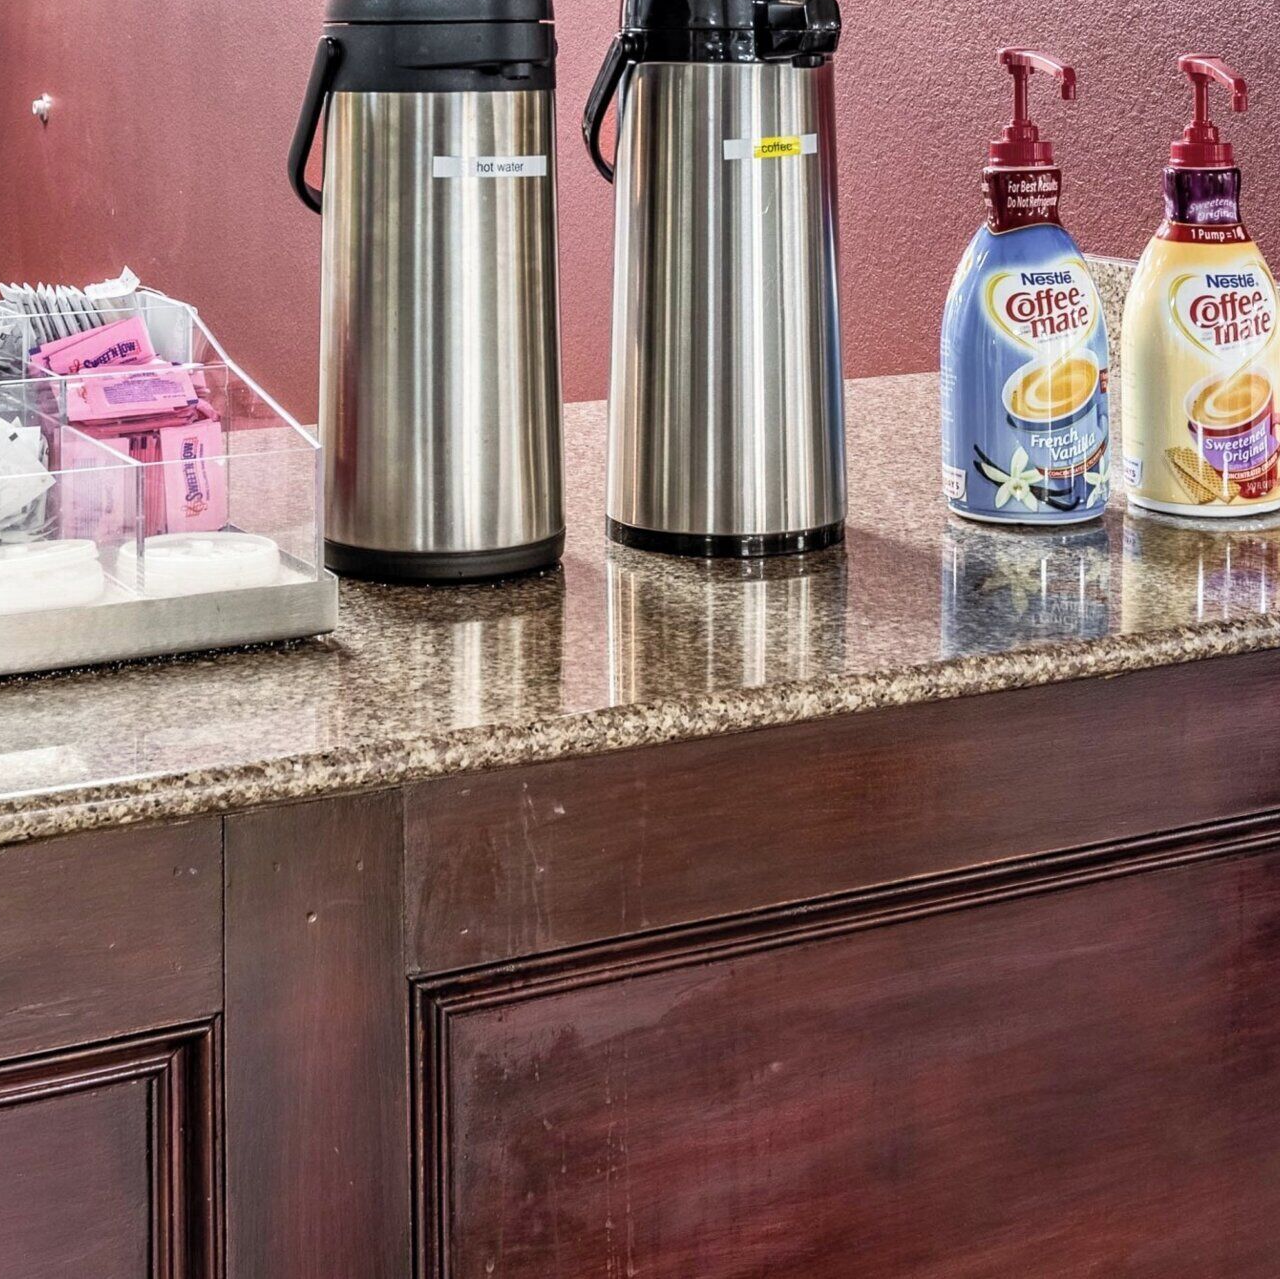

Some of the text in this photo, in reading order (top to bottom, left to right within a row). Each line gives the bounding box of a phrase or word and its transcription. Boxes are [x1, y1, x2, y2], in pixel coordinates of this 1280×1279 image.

[761, 141, 793, 153] coffee
[476, 161, 524, 173] hot water
[1007, 180, 1020, 193] For
[1020, 180, 1037, 193] Best
[1007, 196, 1017, 208] Do
[1017, 195, 1029, 208] Not
[1198, 228, 1226, 242] Pump
[1030, 306, 1089, 338] mate
[1213, 312, 1271, 346] mate
[1030, 427, 1079, 448] French
[1205, 420, 1266, 451] Sweetened
[1050, 432, 1095, 461] Vanilla
